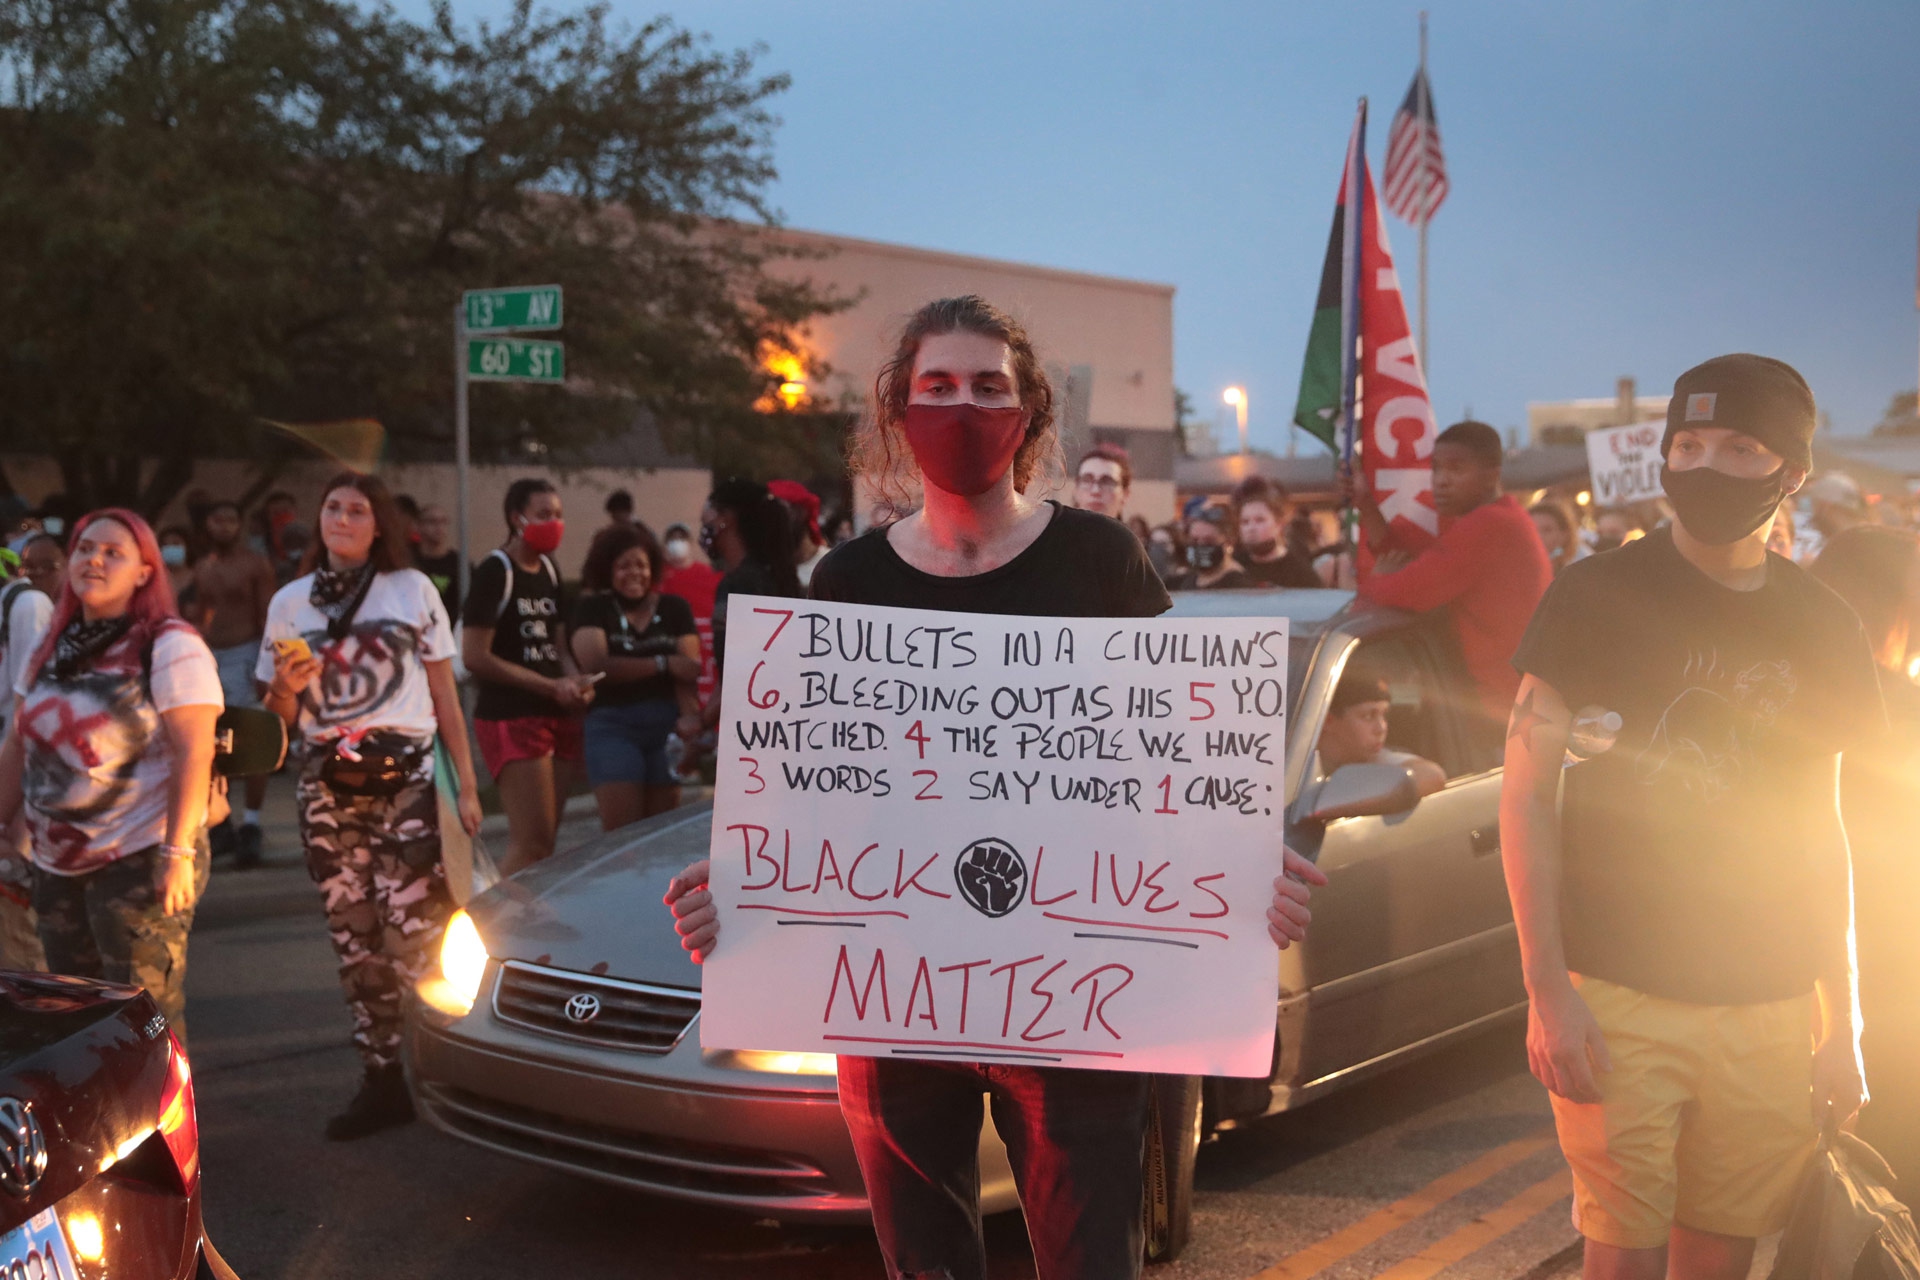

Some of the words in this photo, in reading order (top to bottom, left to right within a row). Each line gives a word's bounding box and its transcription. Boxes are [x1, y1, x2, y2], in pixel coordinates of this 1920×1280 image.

[526, 292, 556, 323] AV
[528, 347, 555, 377] ST
[1596, 460, 1663, 498] VIOLE
[753, 607, 794, 652] 7
[798, 613, 977, 669] BULLETS
[1004, 630, 1041, 666] IN
[1055, 627, 1074, 663] A
[1103, 630, 1283, 668] CIVILIAN'S
[748, 660, 790, 713] 6,
[800, 671, 980, 715] BLEEDING
[991, 684, 1070, 720] OUT
[1071, 685, 1113, 722] AS
[1127, 686, 1172, 718] HIS
[1189, 681, 1216, 721] 5
[736, 718, 888, 753] WATCHED.
[904, 720, 931, 760] 4
[943, 723, 998, 757] THE
[1012, 722, 1132, 761] PEOPLE
[1138, 728, 1192, 763] WE
[1206, 730, 1274, 765] HAVE
[739, 757, 765, 794] 3
[782, 762, 891, 797] WORDS
[912, 769, 943, 801] 2
[969, 770, 1040, 805] SAY
[1051, 774, 1141, 813] UNDER
[1154, 774, 1178, 814] 1
[1185, 775, 1273, 816] CAUSE:
[727, 824, 951, 900] BLACK
[1031, 846, 1229, 918] LIVES
[824, 944, 1133, 1041] MATTER
